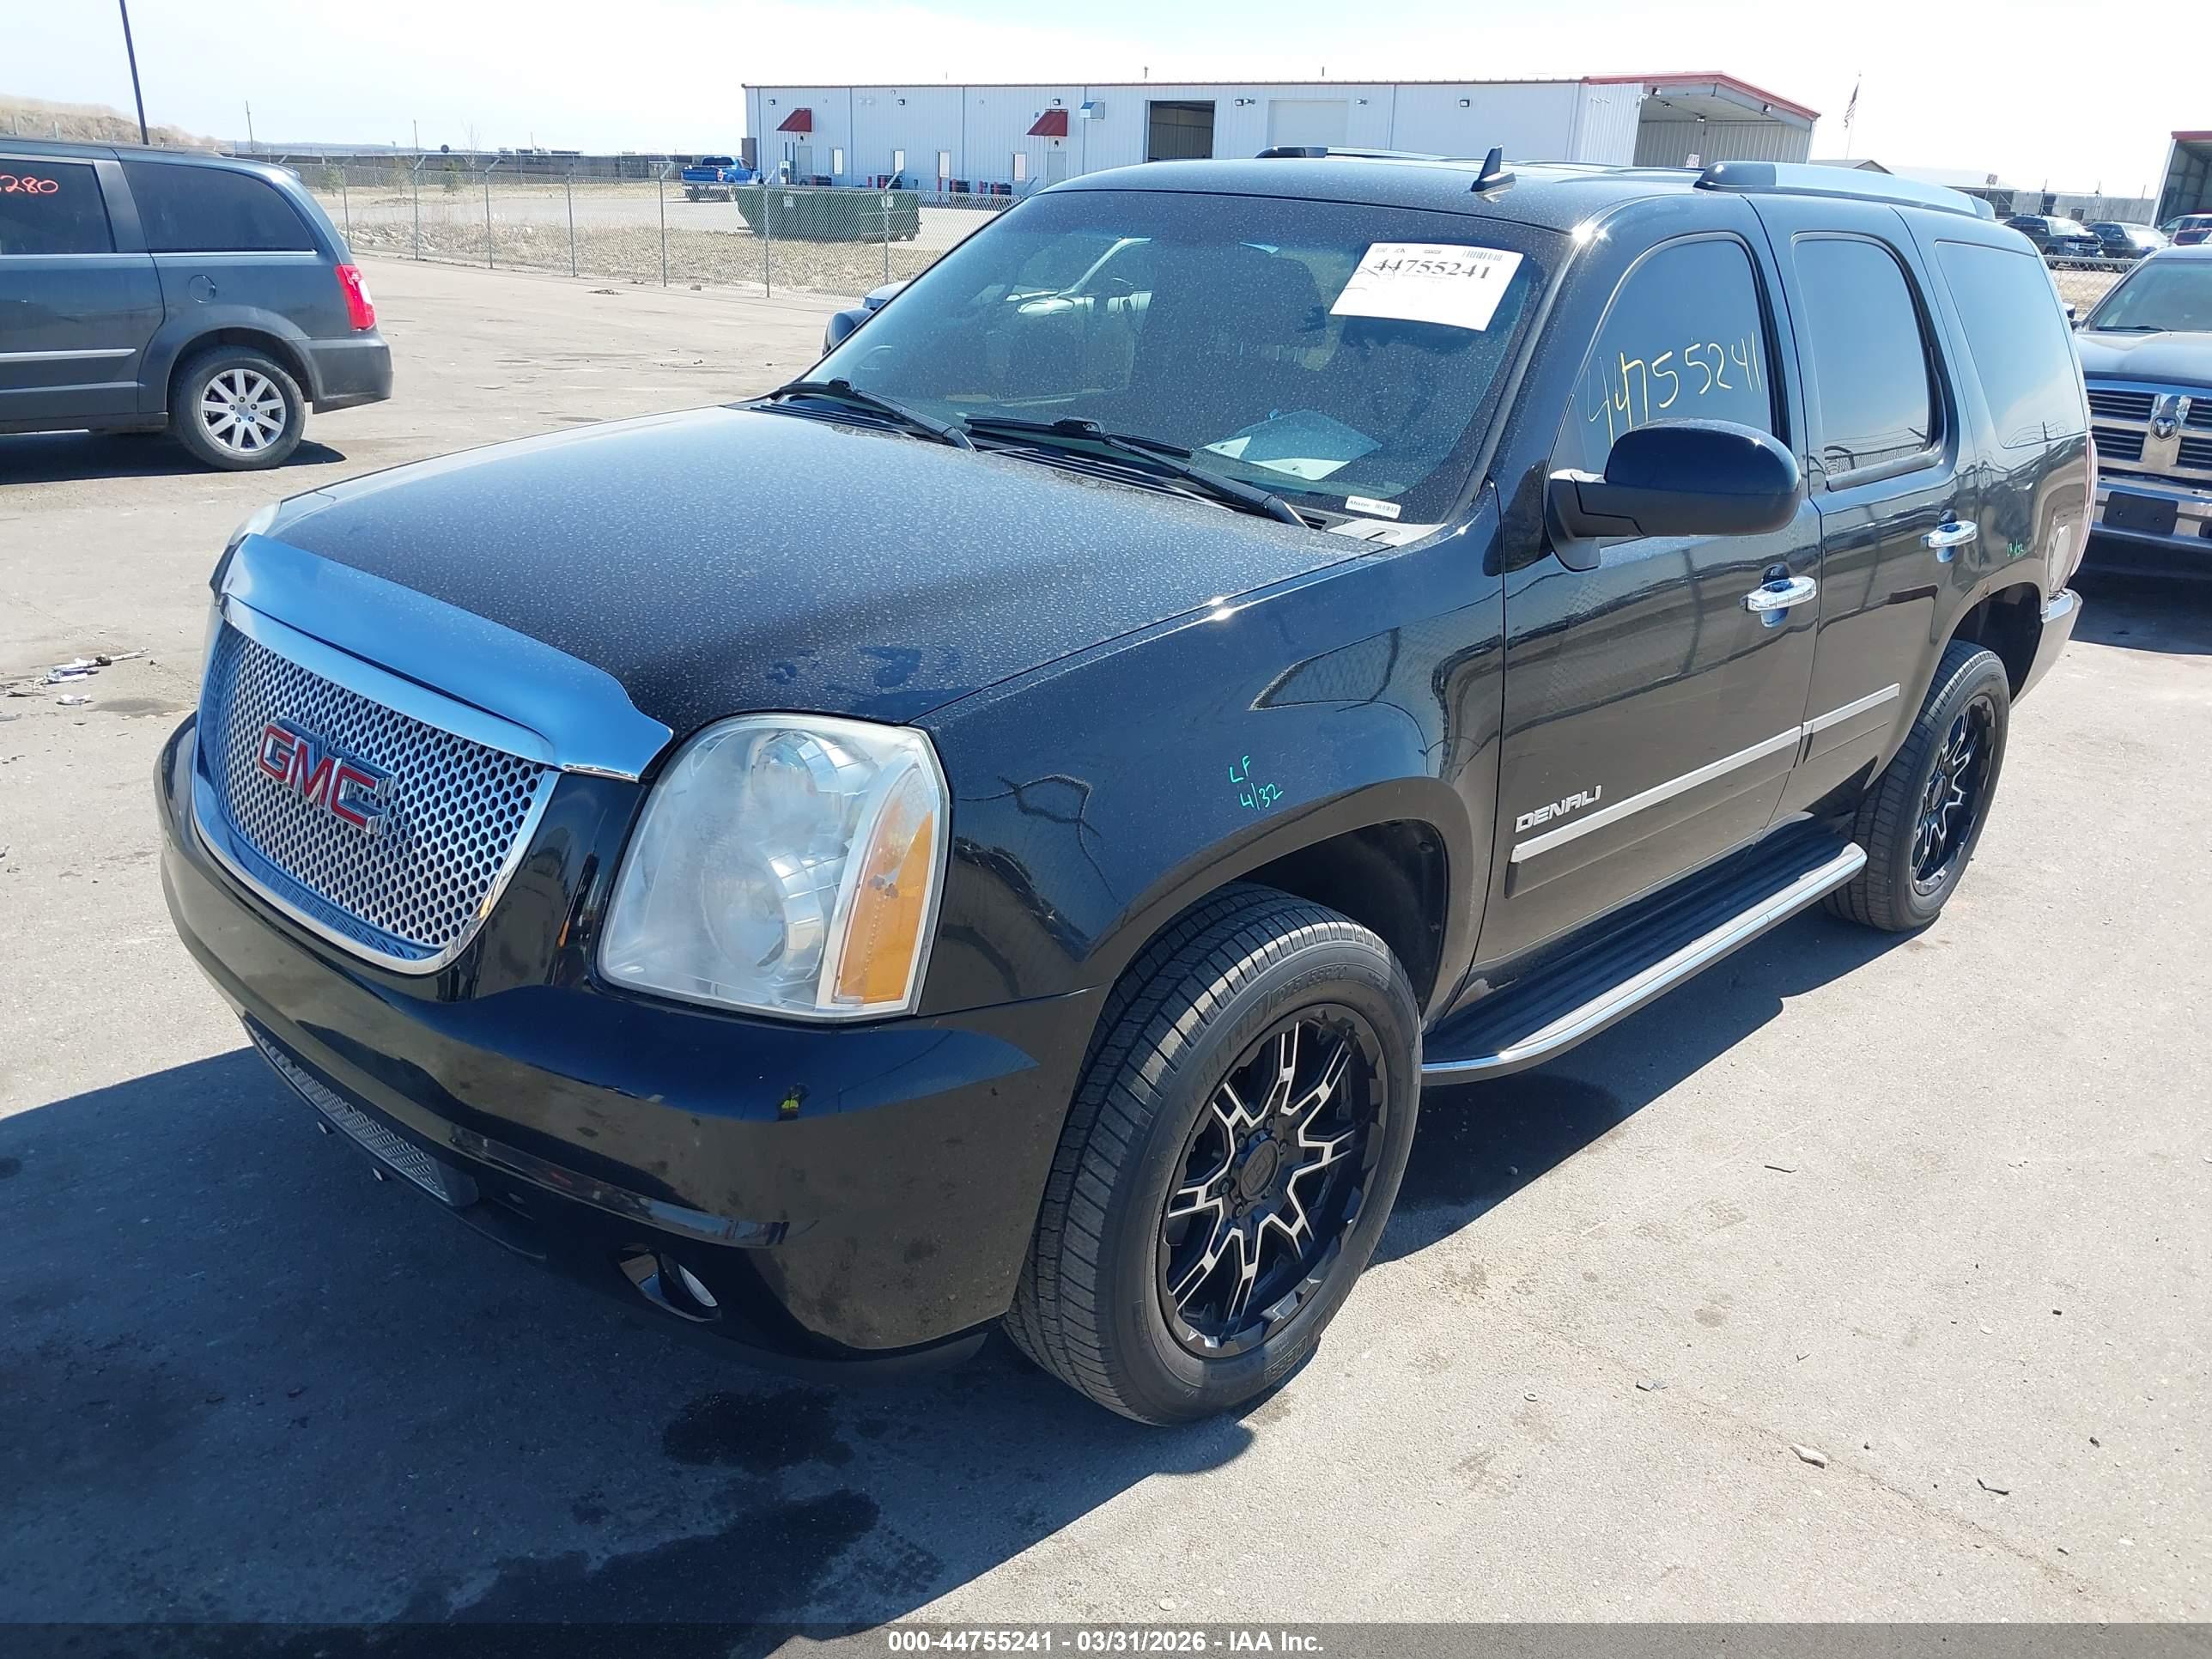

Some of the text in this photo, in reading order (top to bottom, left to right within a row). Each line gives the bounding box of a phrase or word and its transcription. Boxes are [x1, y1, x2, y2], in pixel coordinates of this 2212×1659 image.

[0, 174, 59, 193] 280
[1373, 258, 1492, 280] 44755241
[1586, 330, 1764, 447] 44755241
[258, 721, 386, 836] GMC
[1228, 755, 1251, 783] LF
[1239, 782, 1285, 811] 4/32
[1515, 785, 1602, 833] DENALI
